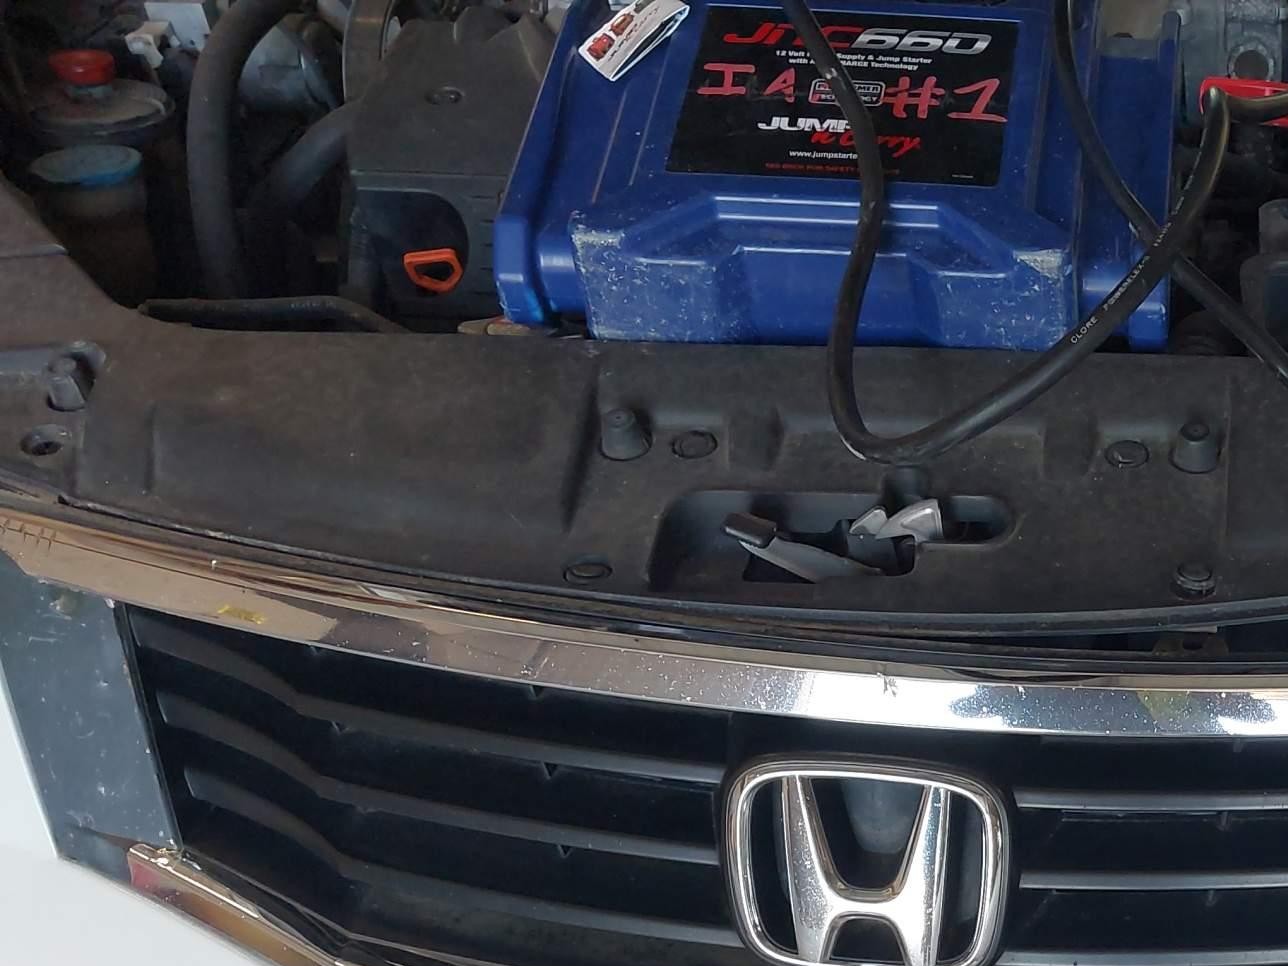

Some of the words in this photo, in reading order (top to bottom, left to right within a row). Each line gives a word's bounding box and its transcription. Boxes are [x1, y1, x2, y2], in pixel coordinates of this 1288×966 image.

[876, 55, 900, 63] Jump
[902, 56, 932, 64] Starter
[870, 61, 919, 71] Technology
[1070, 315, 1099, 344] CLORE
